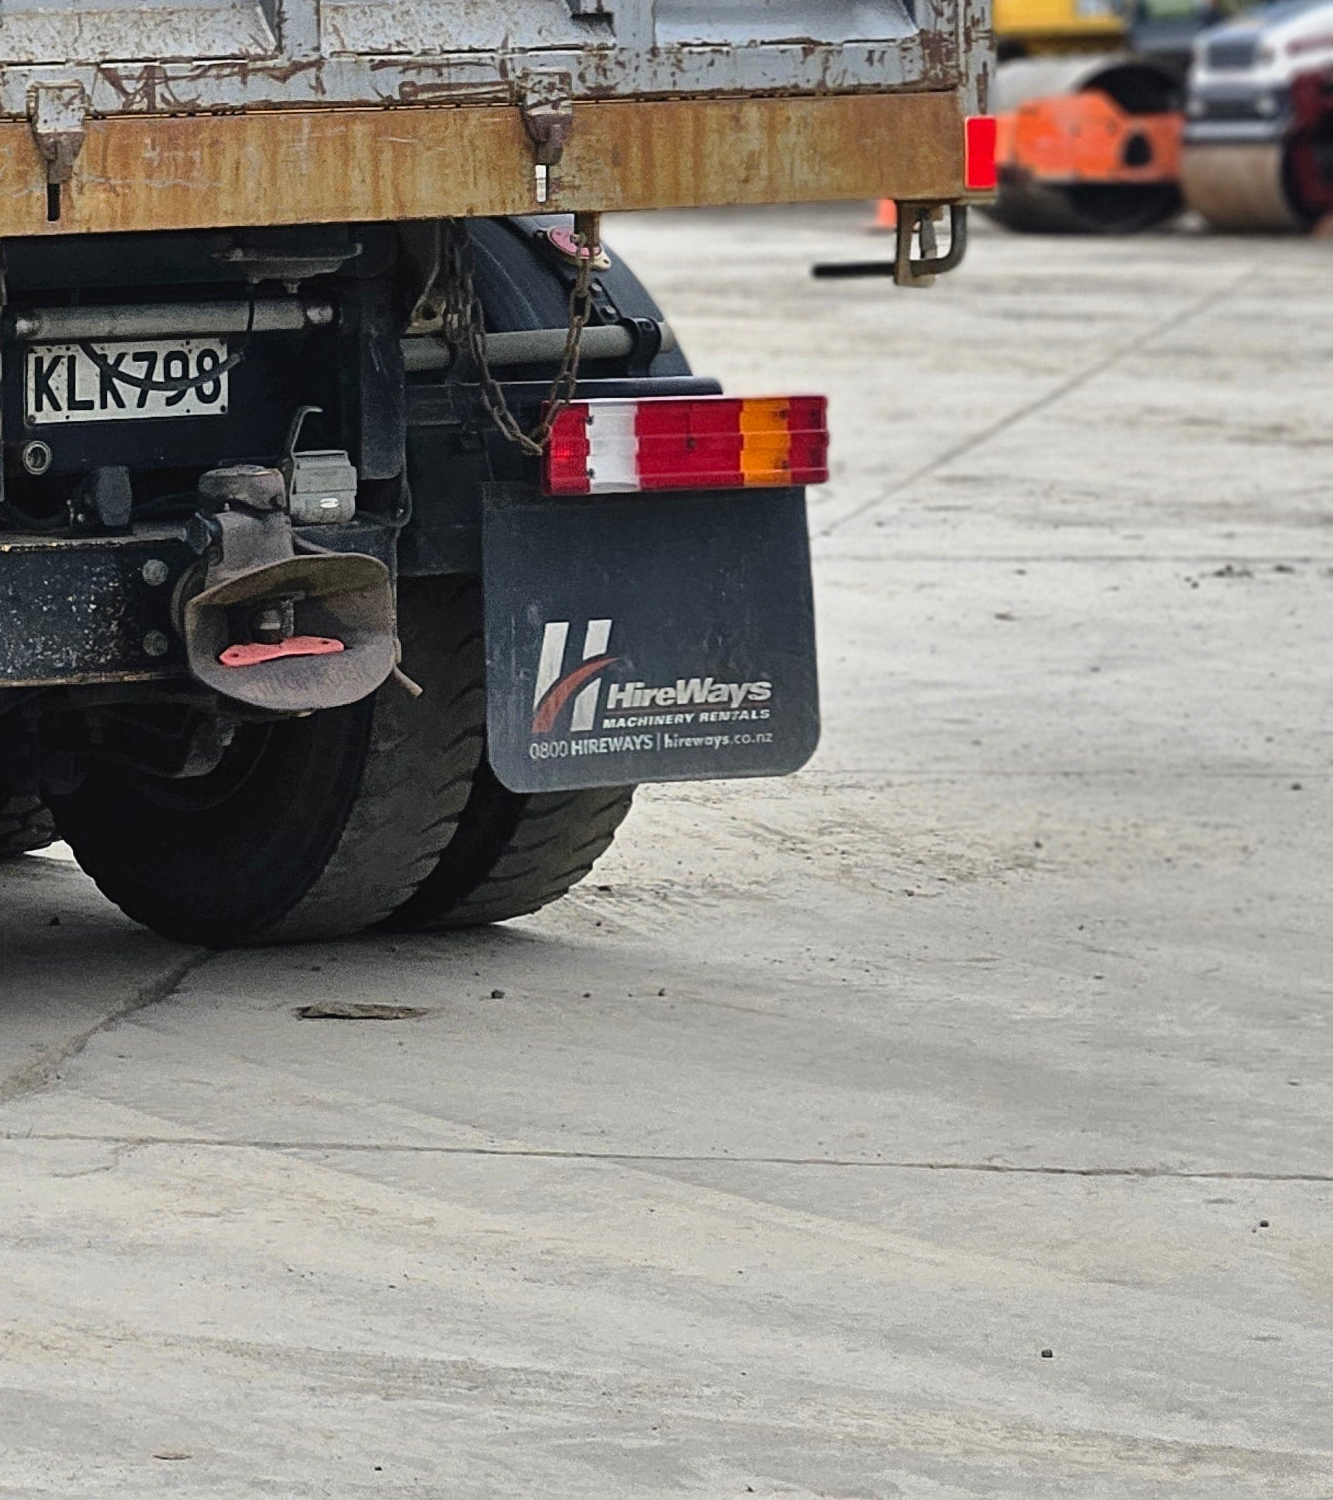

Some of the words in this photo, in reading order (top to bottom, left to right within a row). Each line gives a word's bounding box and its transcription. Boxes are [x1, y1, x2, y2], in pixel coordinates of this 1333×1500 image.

[33, 348, 223, 413] KLK798
[606, 677, 773, 709] HireWays
[602, 712, 695, 729] MACHINERY
[699, 708, 771, 723] RENTALS
[529, 742, 568, 760] 0800
[570, 733, 653, 757] HIREWAYS
[664, 731, 774, 751] hireways.co.nz
